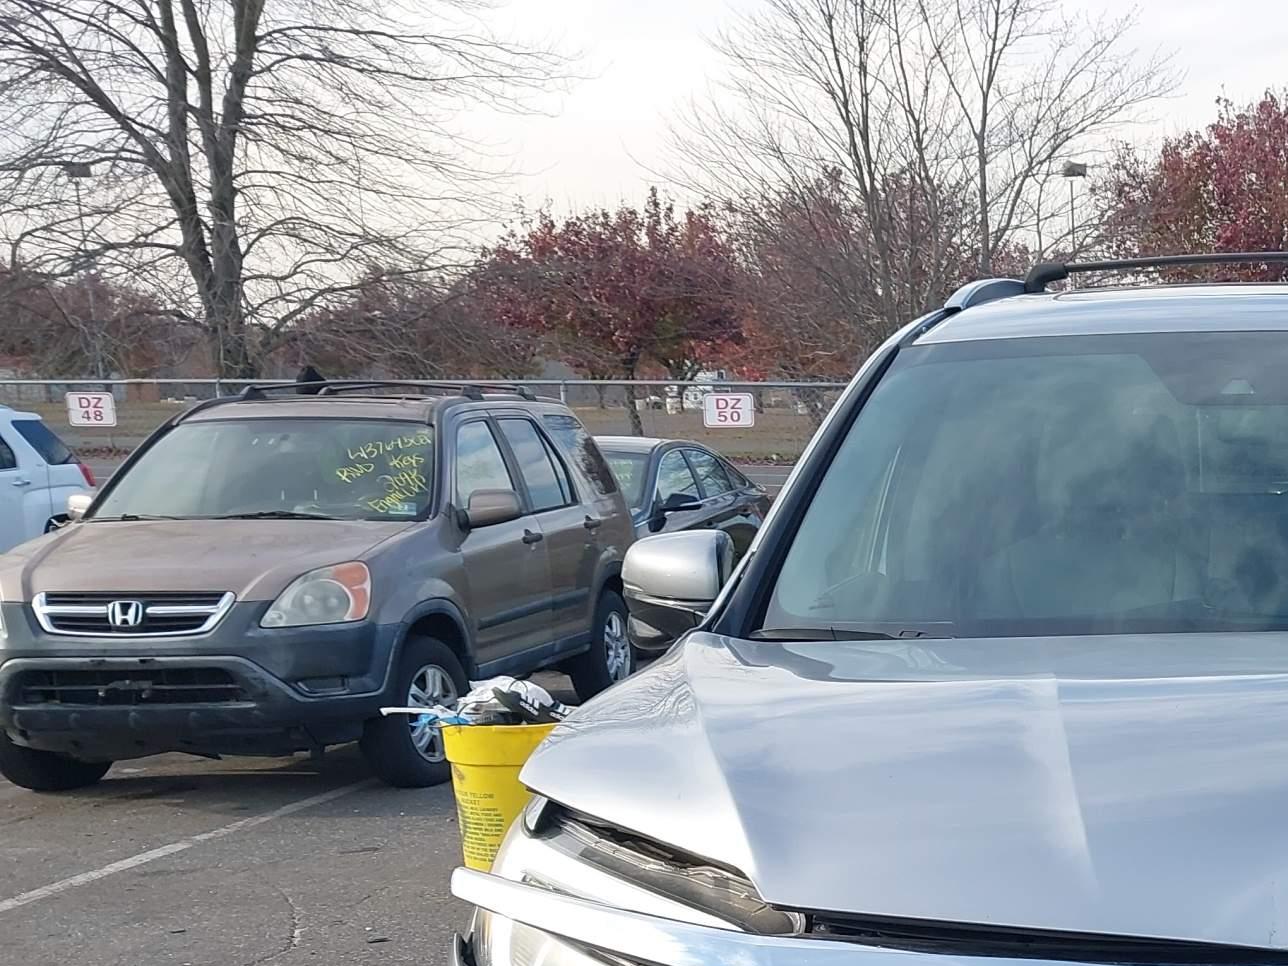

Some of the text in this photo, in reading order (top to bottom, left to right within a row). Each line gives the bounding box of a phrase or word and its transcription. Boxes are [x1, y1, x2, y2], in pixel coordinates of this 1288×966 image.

[78, 397, 104, 409] DZ
[715, 398, 742, 410] DZ
[81, 410, 104, 422] 48
[717, 411, 741, 422] 50
